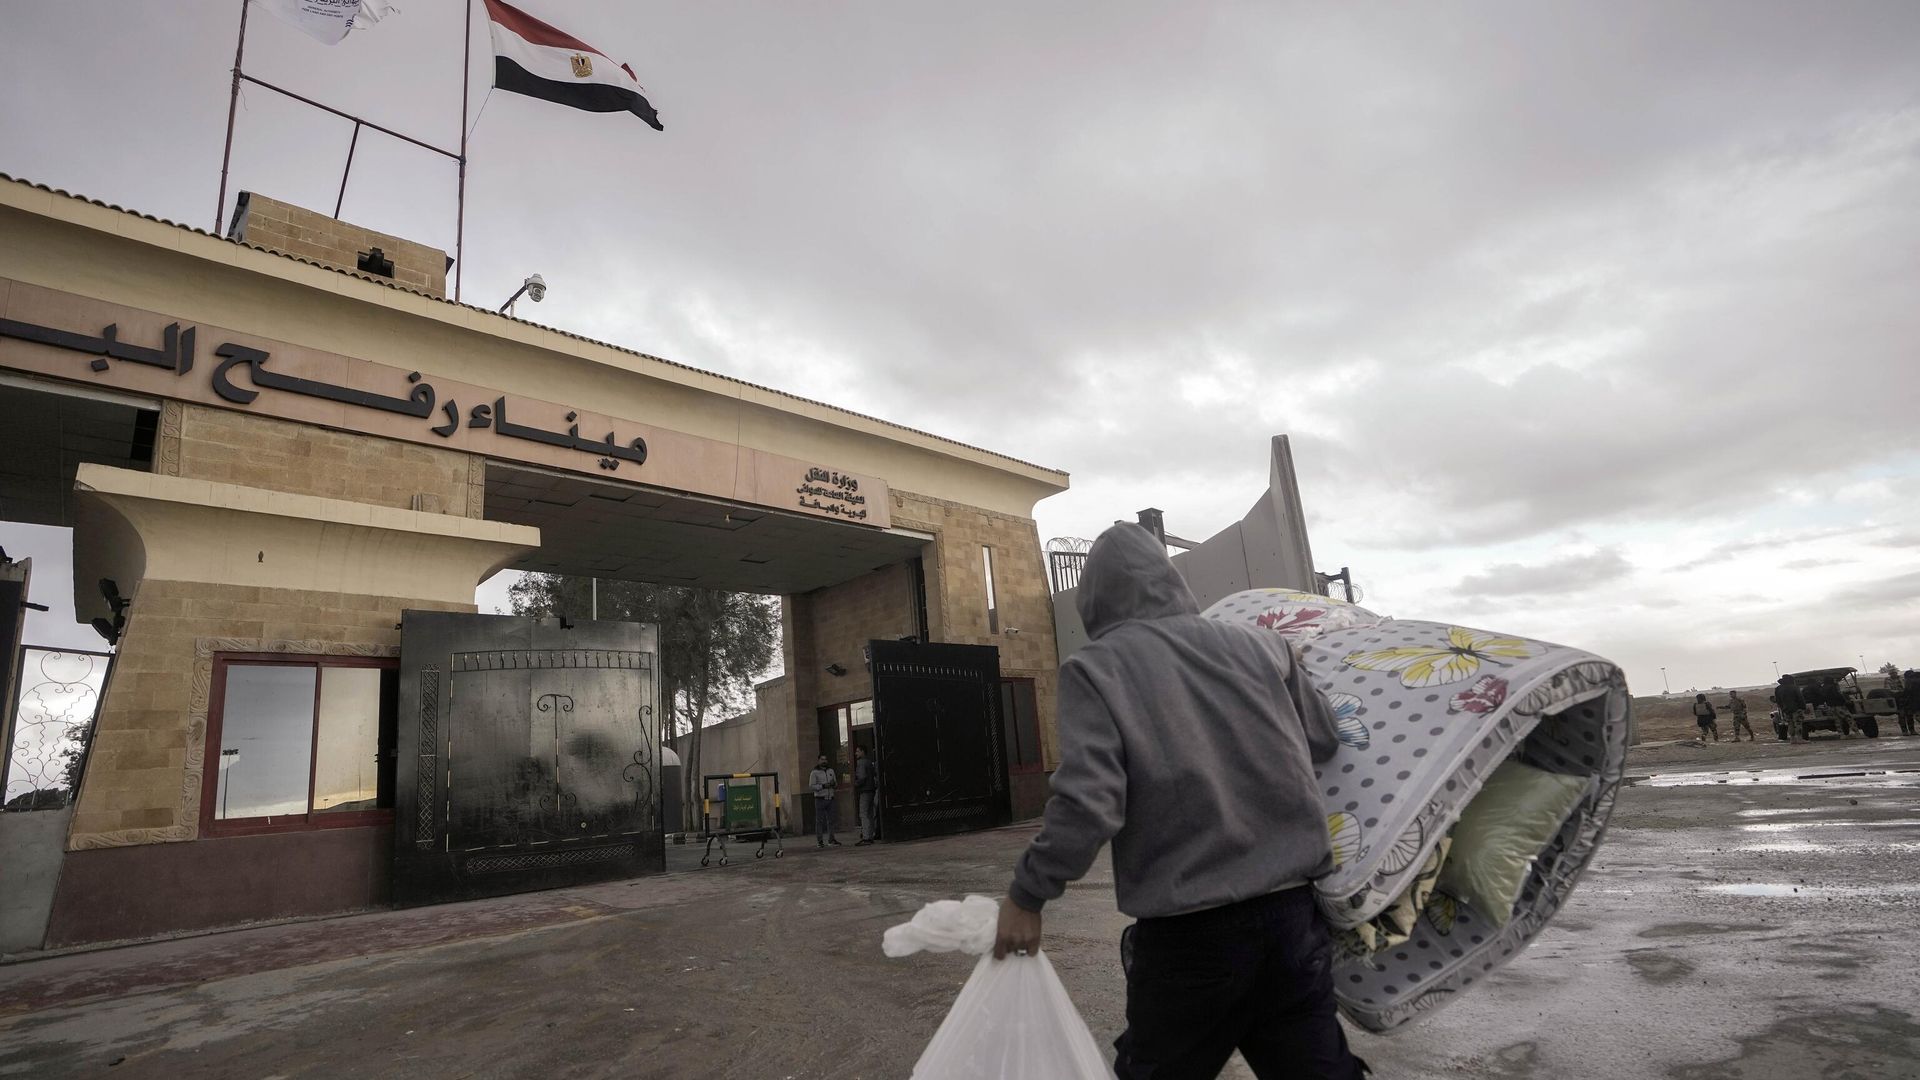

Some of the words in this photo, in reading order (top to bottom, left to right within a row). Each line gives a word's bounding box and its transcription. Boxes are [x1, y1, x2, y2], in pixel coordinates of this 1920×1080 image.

[211, 341, 458, 437] رفح
[468, 396, 648, 470] ميناء
[804, 467, 830, 483] النقل
[831, 471, 858, 492] وزارة
